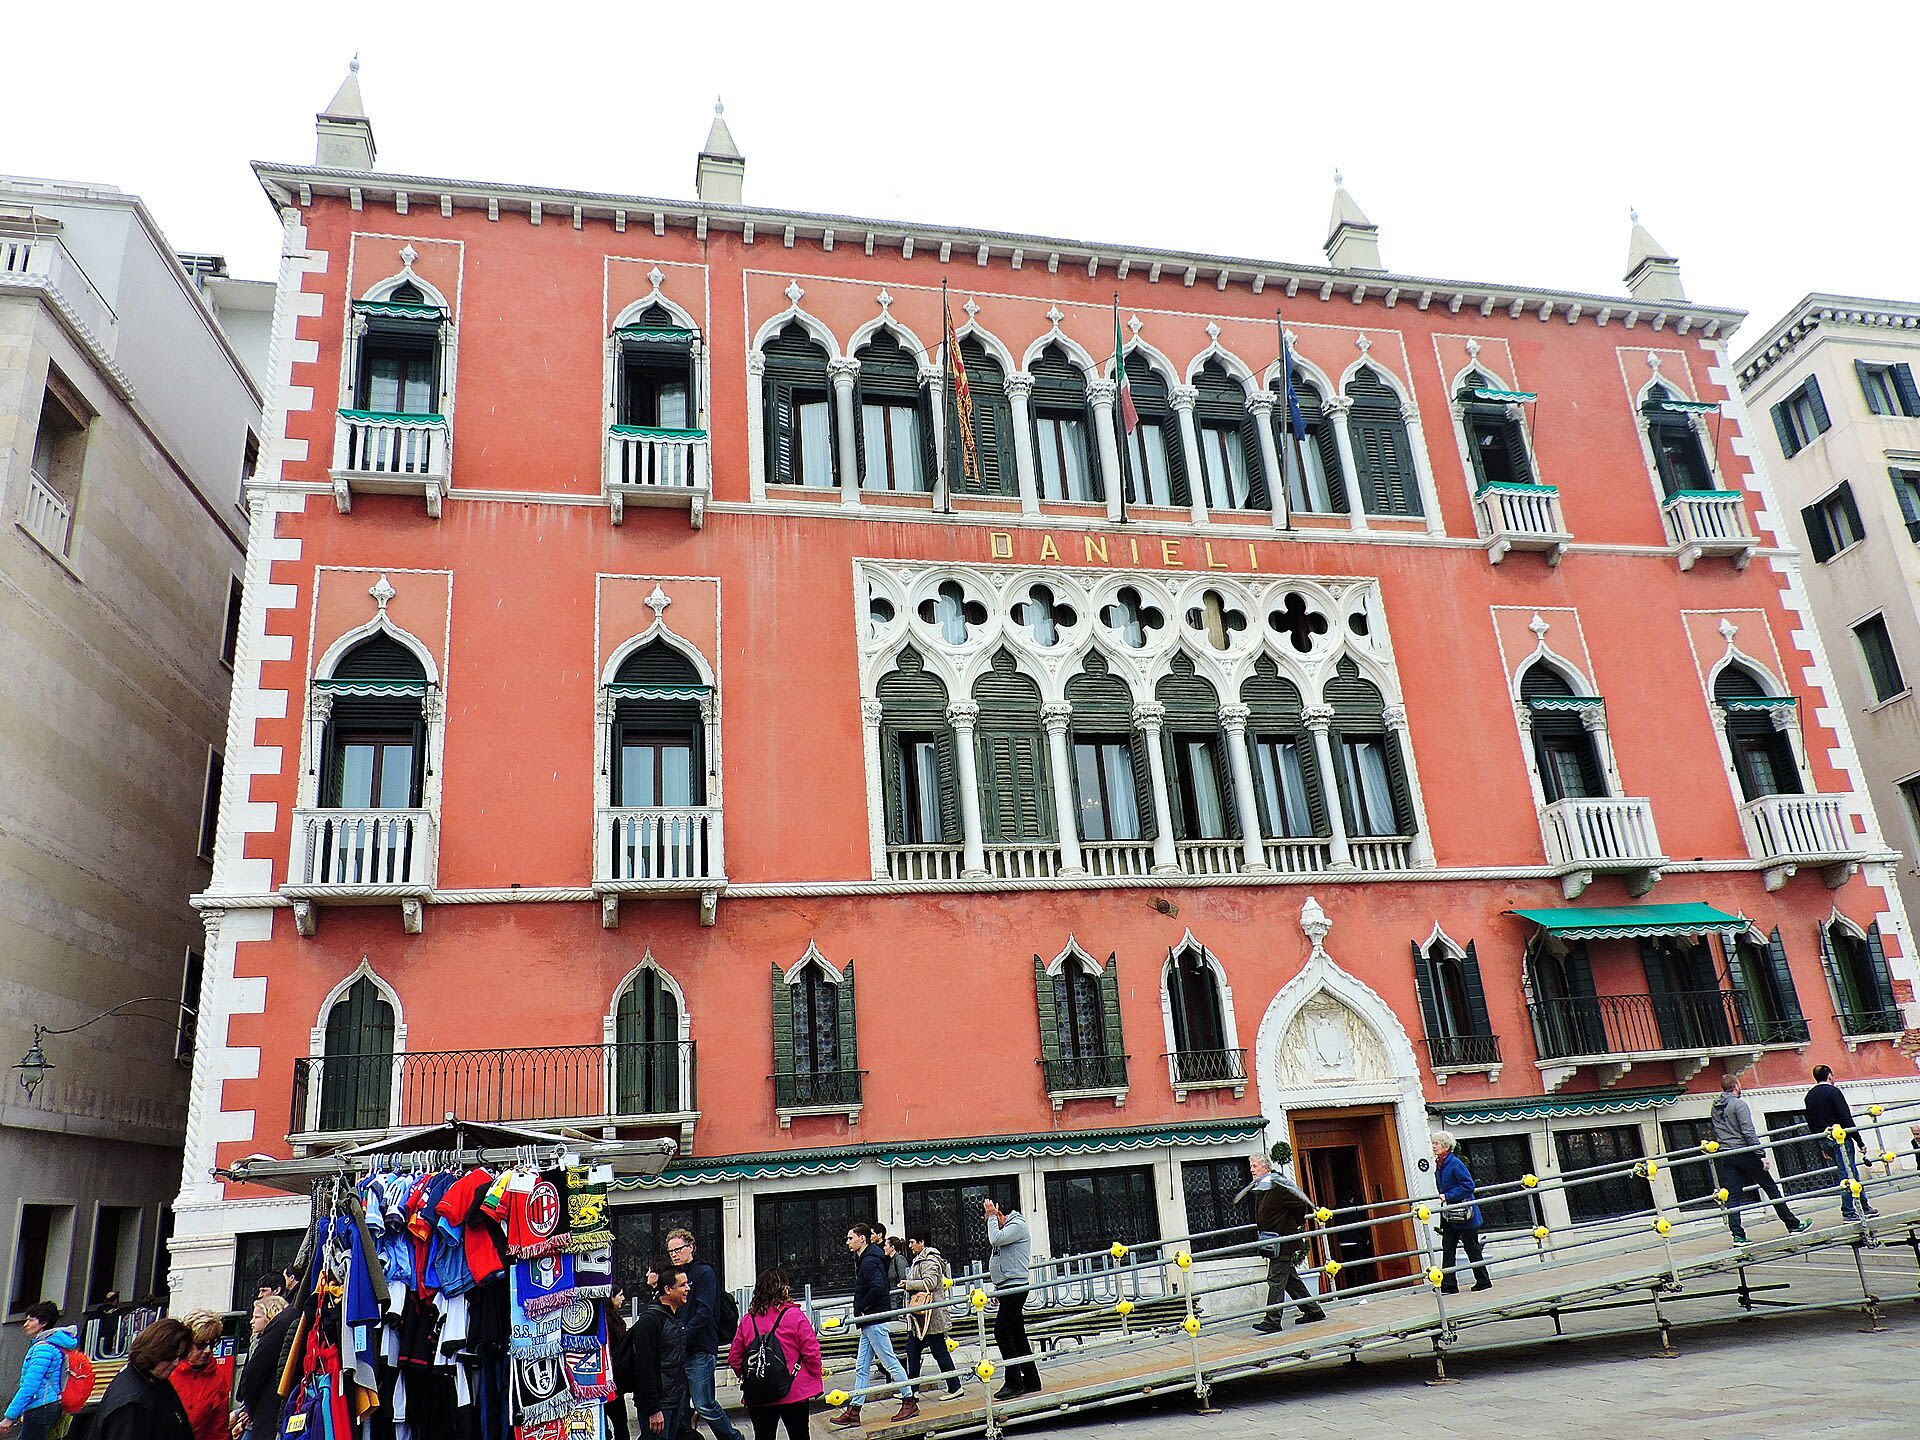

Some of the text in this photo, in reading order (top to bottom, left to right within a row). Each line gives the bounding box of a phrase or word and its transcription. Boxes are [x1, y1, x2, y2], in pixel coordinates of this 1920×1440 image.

[989, 531, 1258, 571] DANIELI
[533, 1186, 552, 1200] ACM
[514, 1325, 532, 1338] S.S.
